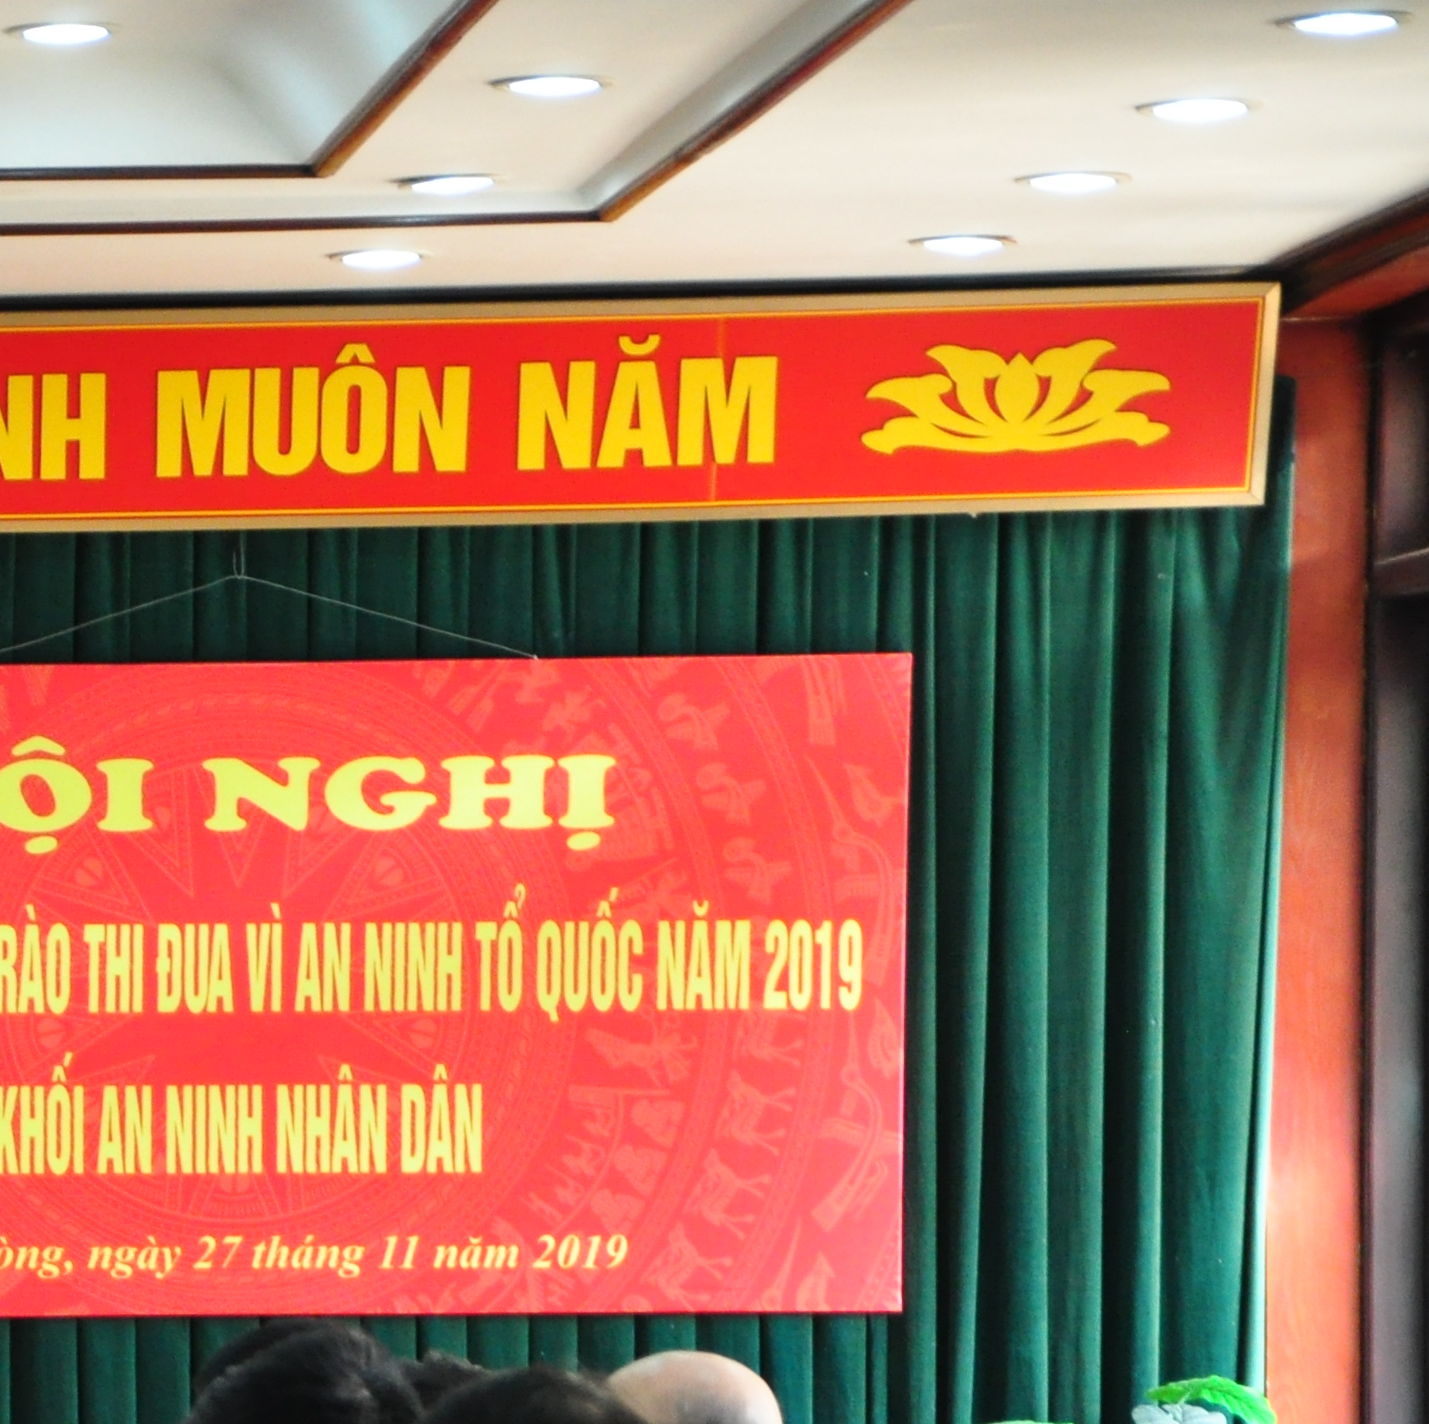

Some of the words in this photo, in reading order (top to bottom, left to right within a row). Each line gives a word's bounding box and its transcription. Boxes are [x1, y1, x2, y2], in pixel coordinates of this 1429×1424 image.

[156, 344, 470, 478] MUÔN
[518, 332, 778, 473] NĂM
[202, 754, 617, 851] NGHỊ
[83, 924, 144, 1014] THI
[156, 923, 233, 1014] ĐUA
[246, 903, 283, 1013] VÌ
[295, 922, 351, 1012] AN
[364, 922, 465, 1012] NINH
[475, 883, 526, 1012] TỔ
[536, 887, 644, 1023] QUỐC
[656, 899, 752, 1012] NĂM
[762, 918, 864, 1015] 2019
[97, 1085, 153, 1174] AN
[166, 1085, 263, 1175] NINH
[276, 1064, 388, 1174] NHÂN
[400, 1064, 483, 1174] DÂN
[86, 1235, 182, 1280] ngày
[193, 1235, 243, 1271] 27
[251, 1233, 366, 1279] tháng
[379, 1234, 419, 1270] 11
[432, 1236, 521, 1272] năm
[529, 1232, 629, 1272] 2019
